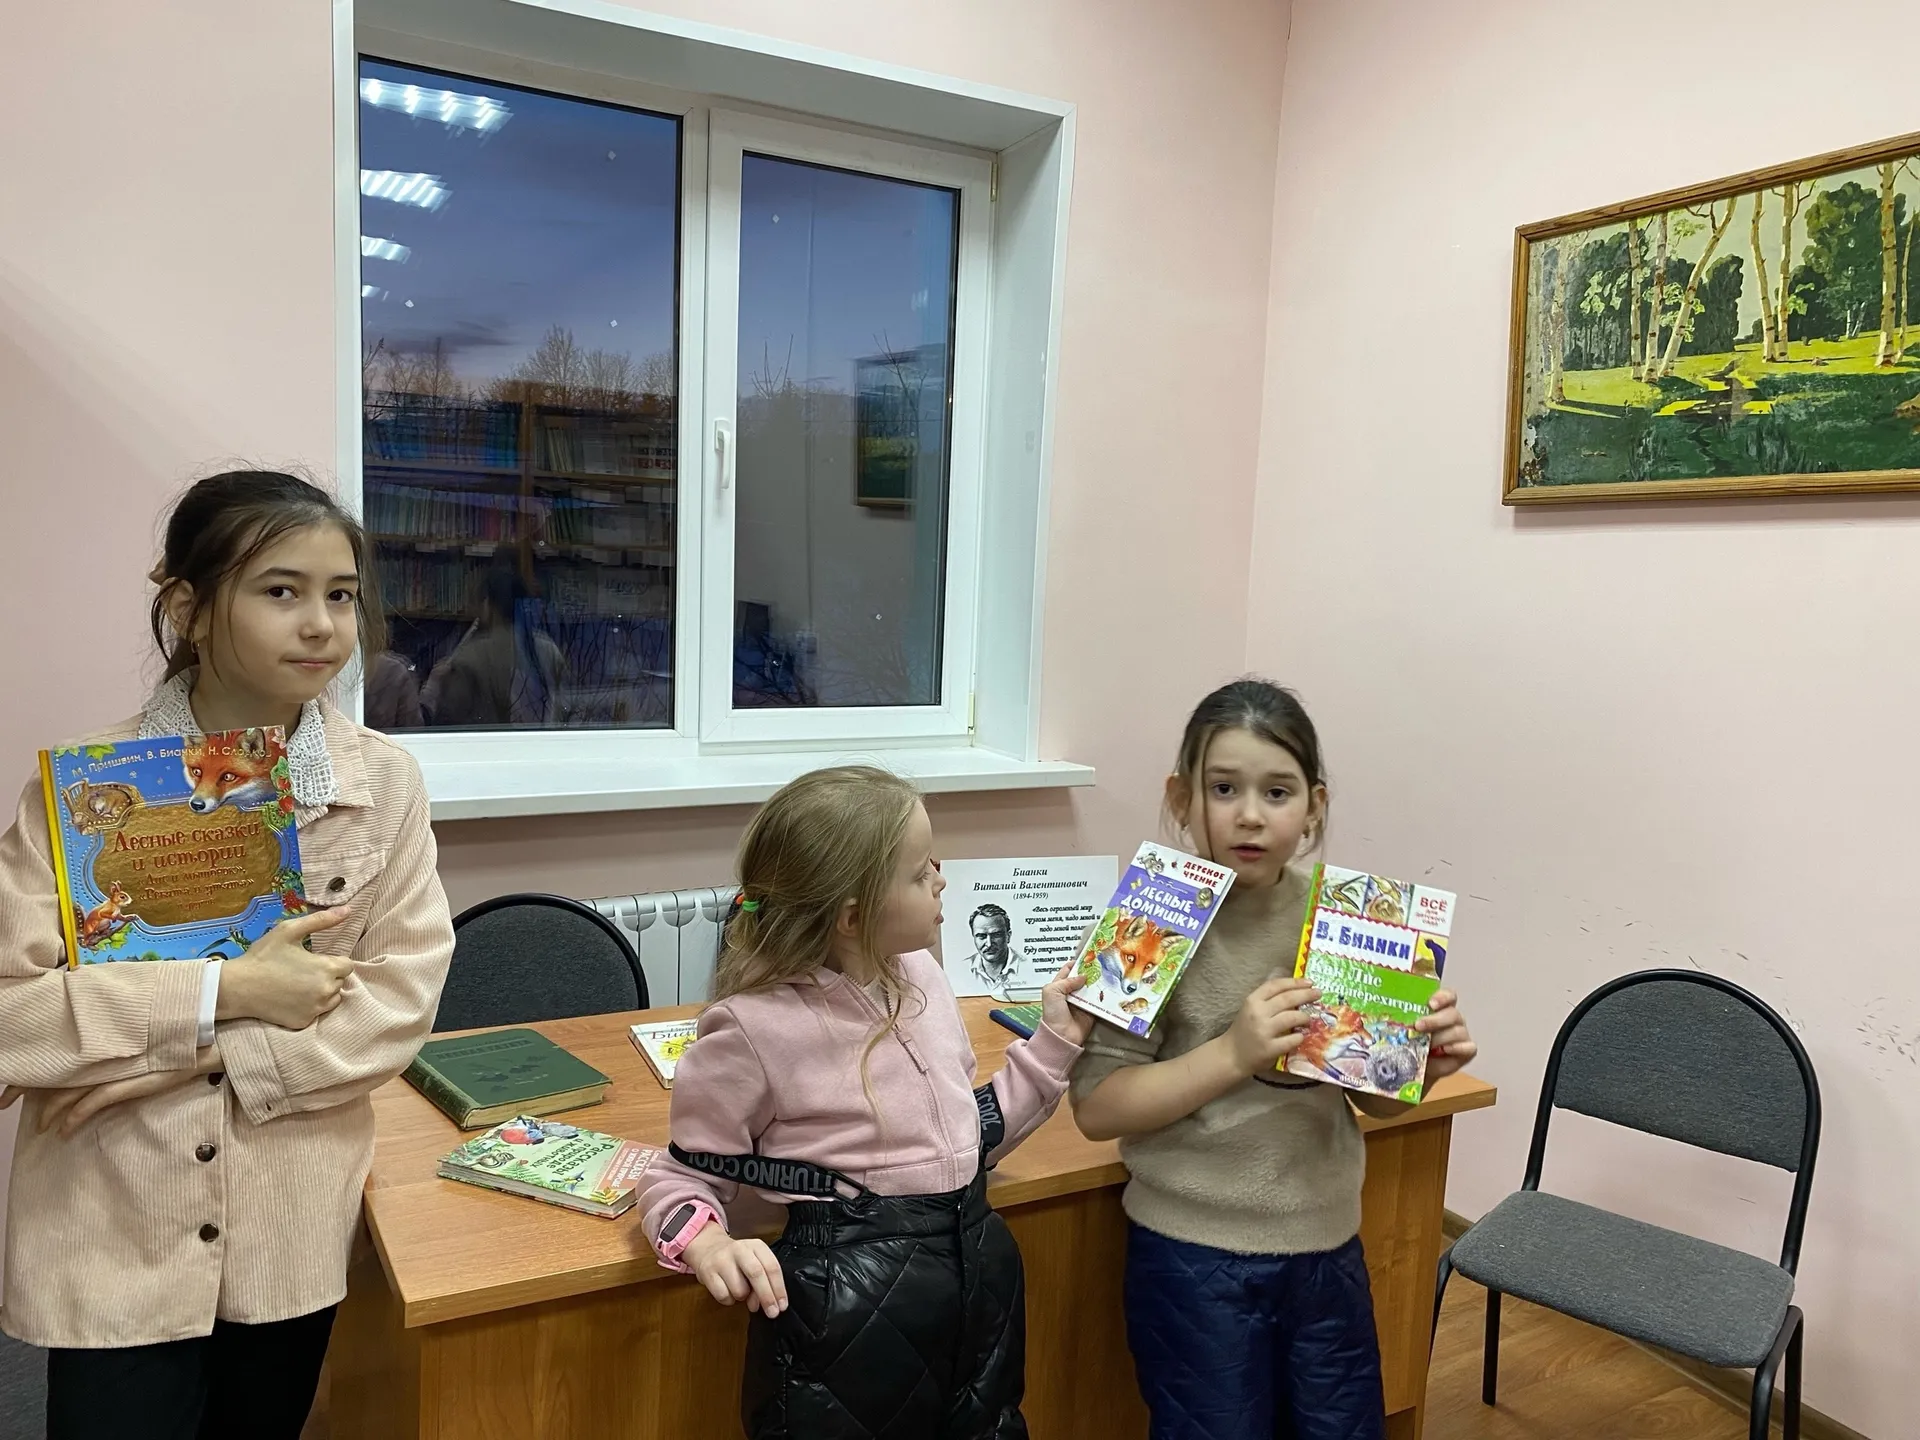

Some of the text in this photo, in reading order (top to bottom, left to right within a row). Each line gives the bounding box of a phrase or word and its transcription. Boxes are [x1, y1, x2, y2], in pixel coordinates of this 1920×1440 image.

[72, 768, 86, 778] М.
[88, 754, 145, 774] Пришвин,
[147, 749, 157, 760] В.
[208, 746, 220, 756] Н.
[110, 821, 261, 853] Лесные сказки
[132, 843, 247, 871] и истории
[1012, 868, 1048, 877] Бианки
[1183, 861, 1226, 881] ДЕТСКОЕ
[1183, 870, 1219, 888] ЧТЕНИЕ
[973, 880, 1088, 891] Виталий Валентинович
[1012, 892, 1049, 900] (1894-1959)
[1049, 904, 1080, 914] огромный
[1139, 886, 1195, 914] ЛЕСНЫЕ
[1420, 897, 1448, 913] ВСЁ
[1025, 916, 1046, 925] кругом
[1120, 894, 1200, 931] ДОМИШКИ
[1316, 920, 1333, 942] В.
[1024, 946, 1037, 955] буду
[1309, 959, 1382, 987] Как Лис
[1348, 987, 1430, 1015] перехитрил
[530, 1141, 577, 1168] животных
[547, 1146, 587, 1169] природе
[552, 1143, 615, 1176] Рассказы
[743, 1159, 832, 1193] iTURINO
